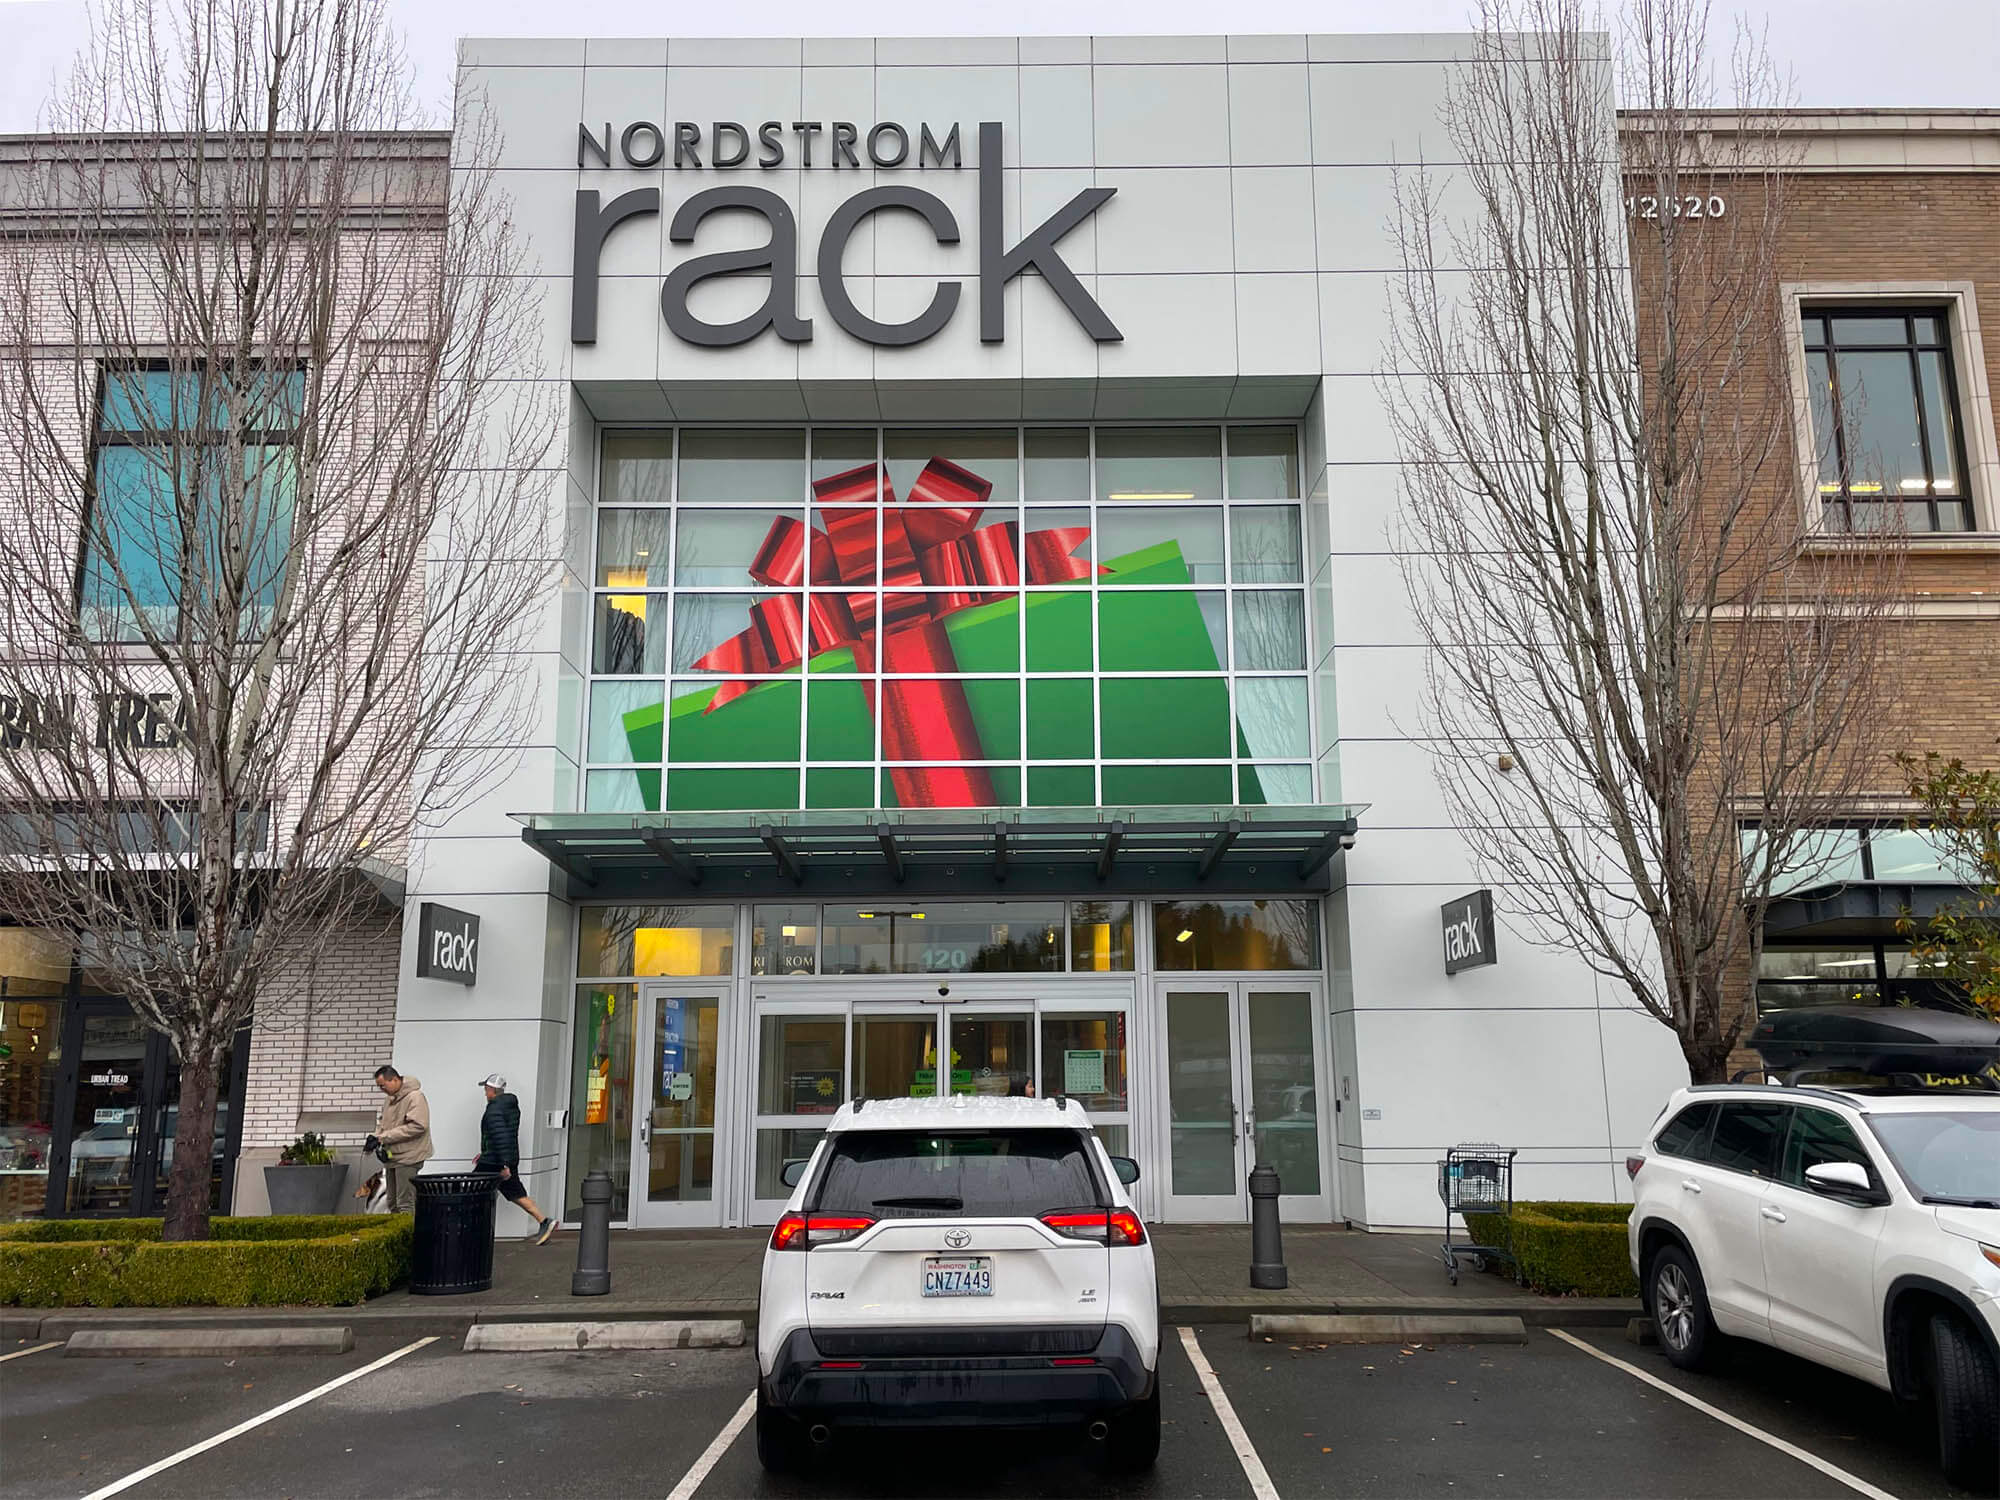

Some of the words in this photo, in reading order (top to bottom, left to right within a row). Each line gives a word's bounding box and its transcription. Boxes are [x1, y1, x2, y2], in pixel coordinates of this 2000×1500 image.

[577, 121, 962, 168] NORDSTROM
[571, 121, 1125, 347] rack
[92, 693, 198, 749] TREA
[433, 922, 475, 974] rack
[920, 949, 969, 969] 120
[1444, 904, 1482, 962] rack
[926, 1271, 990, 1290] CNZ7449
